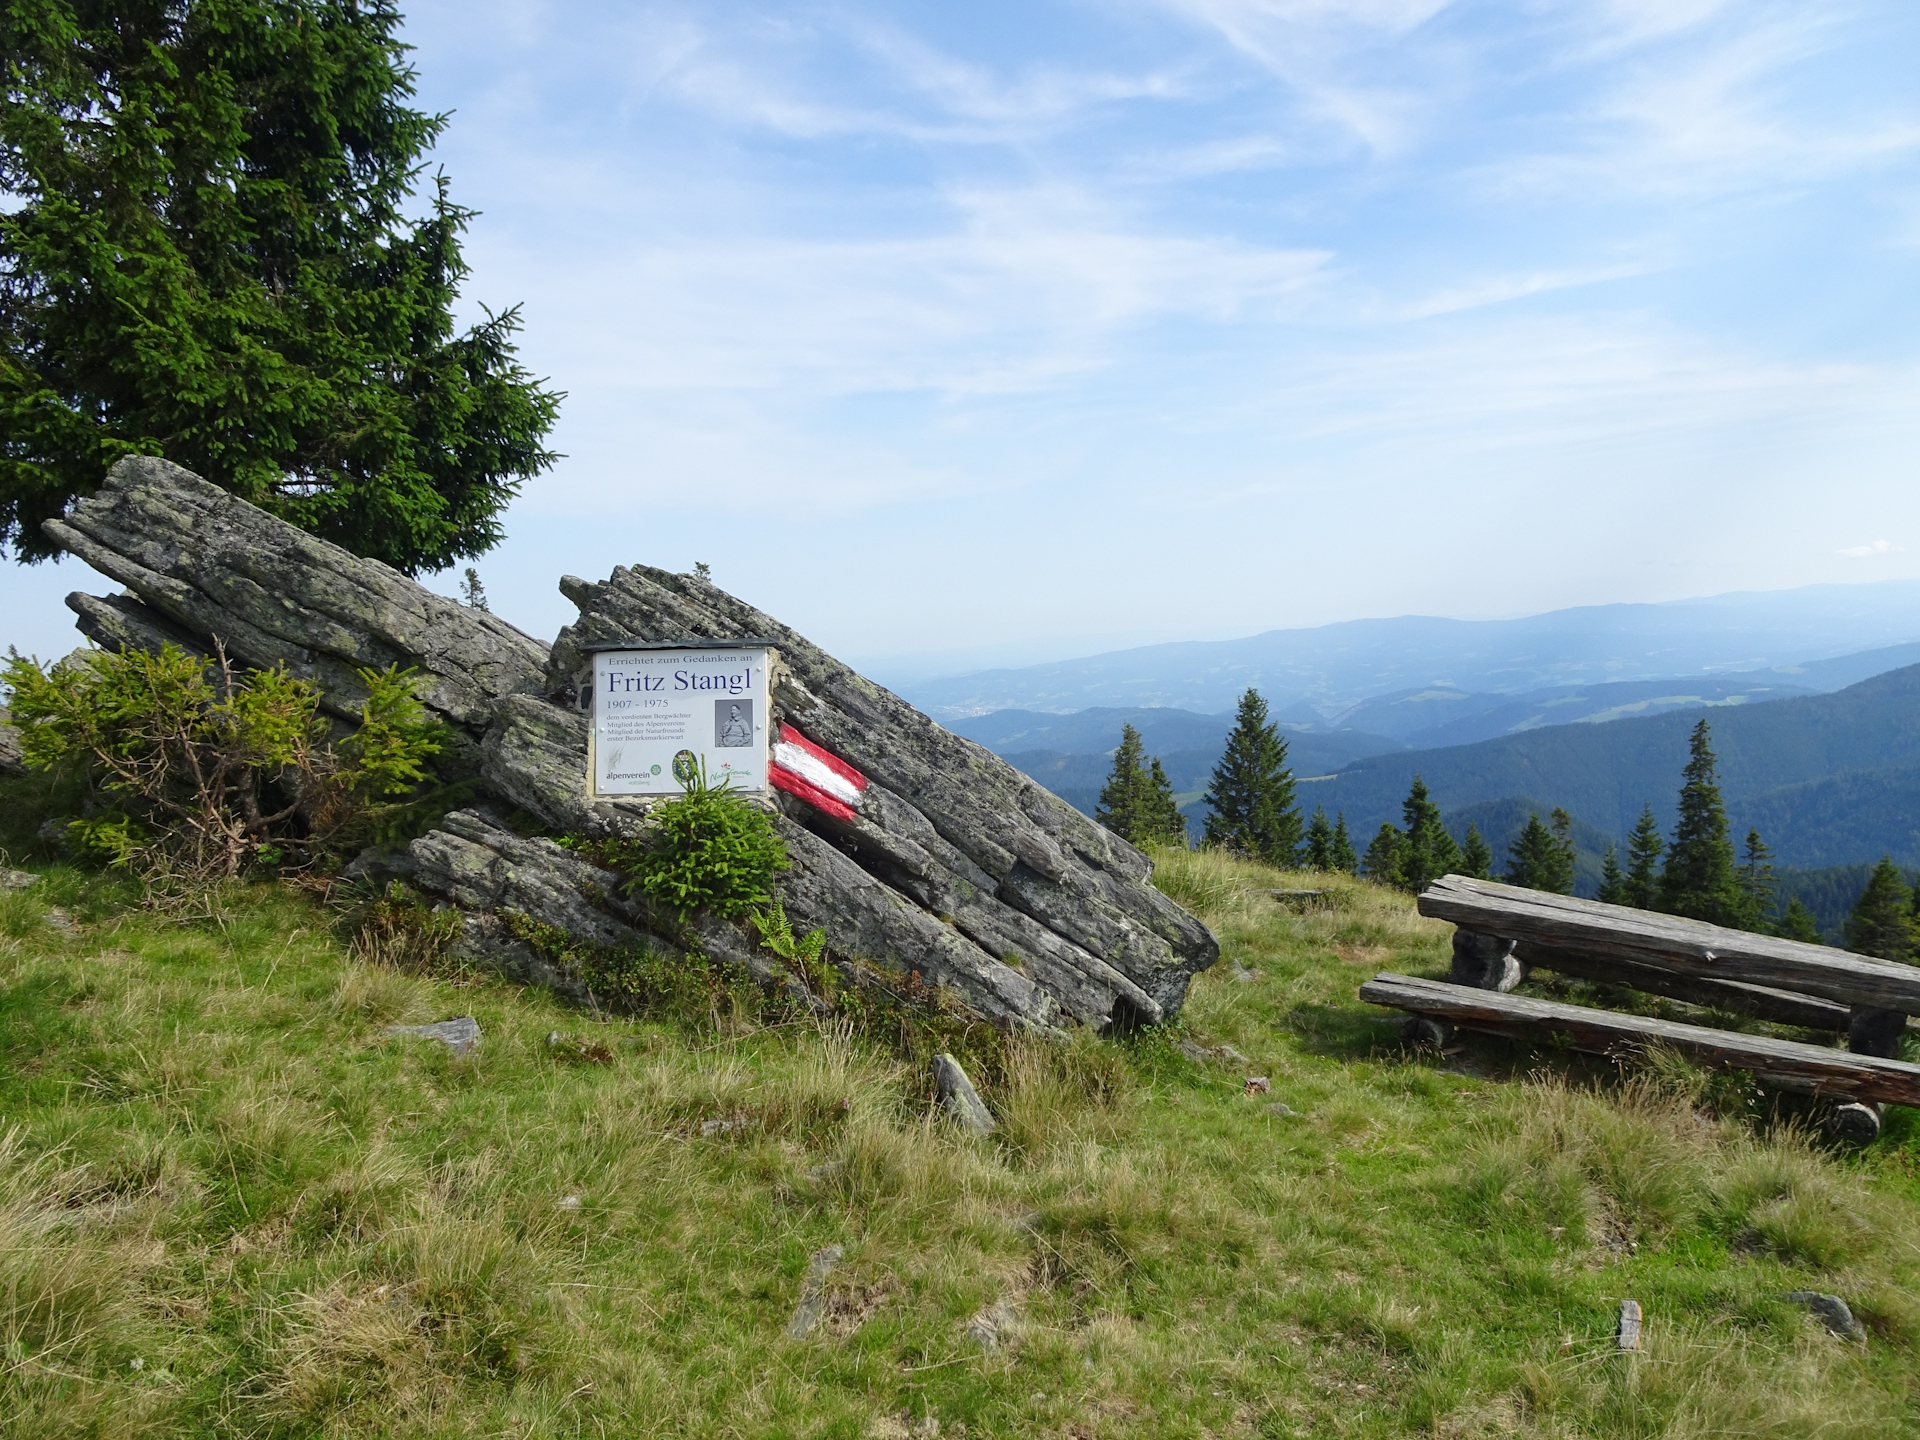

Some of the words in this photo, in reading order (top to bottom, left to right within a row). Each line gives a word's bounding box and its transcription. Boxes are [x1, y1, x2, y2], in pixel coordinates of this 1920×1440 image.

[683, 655, 736, 663] Gedanken
[608, 671, 665, 692] Fritz
[674, 668, 752, 694] Stangl
[607, 700, 632, 709] 1907
[644, 699, 669, 708] 1975
